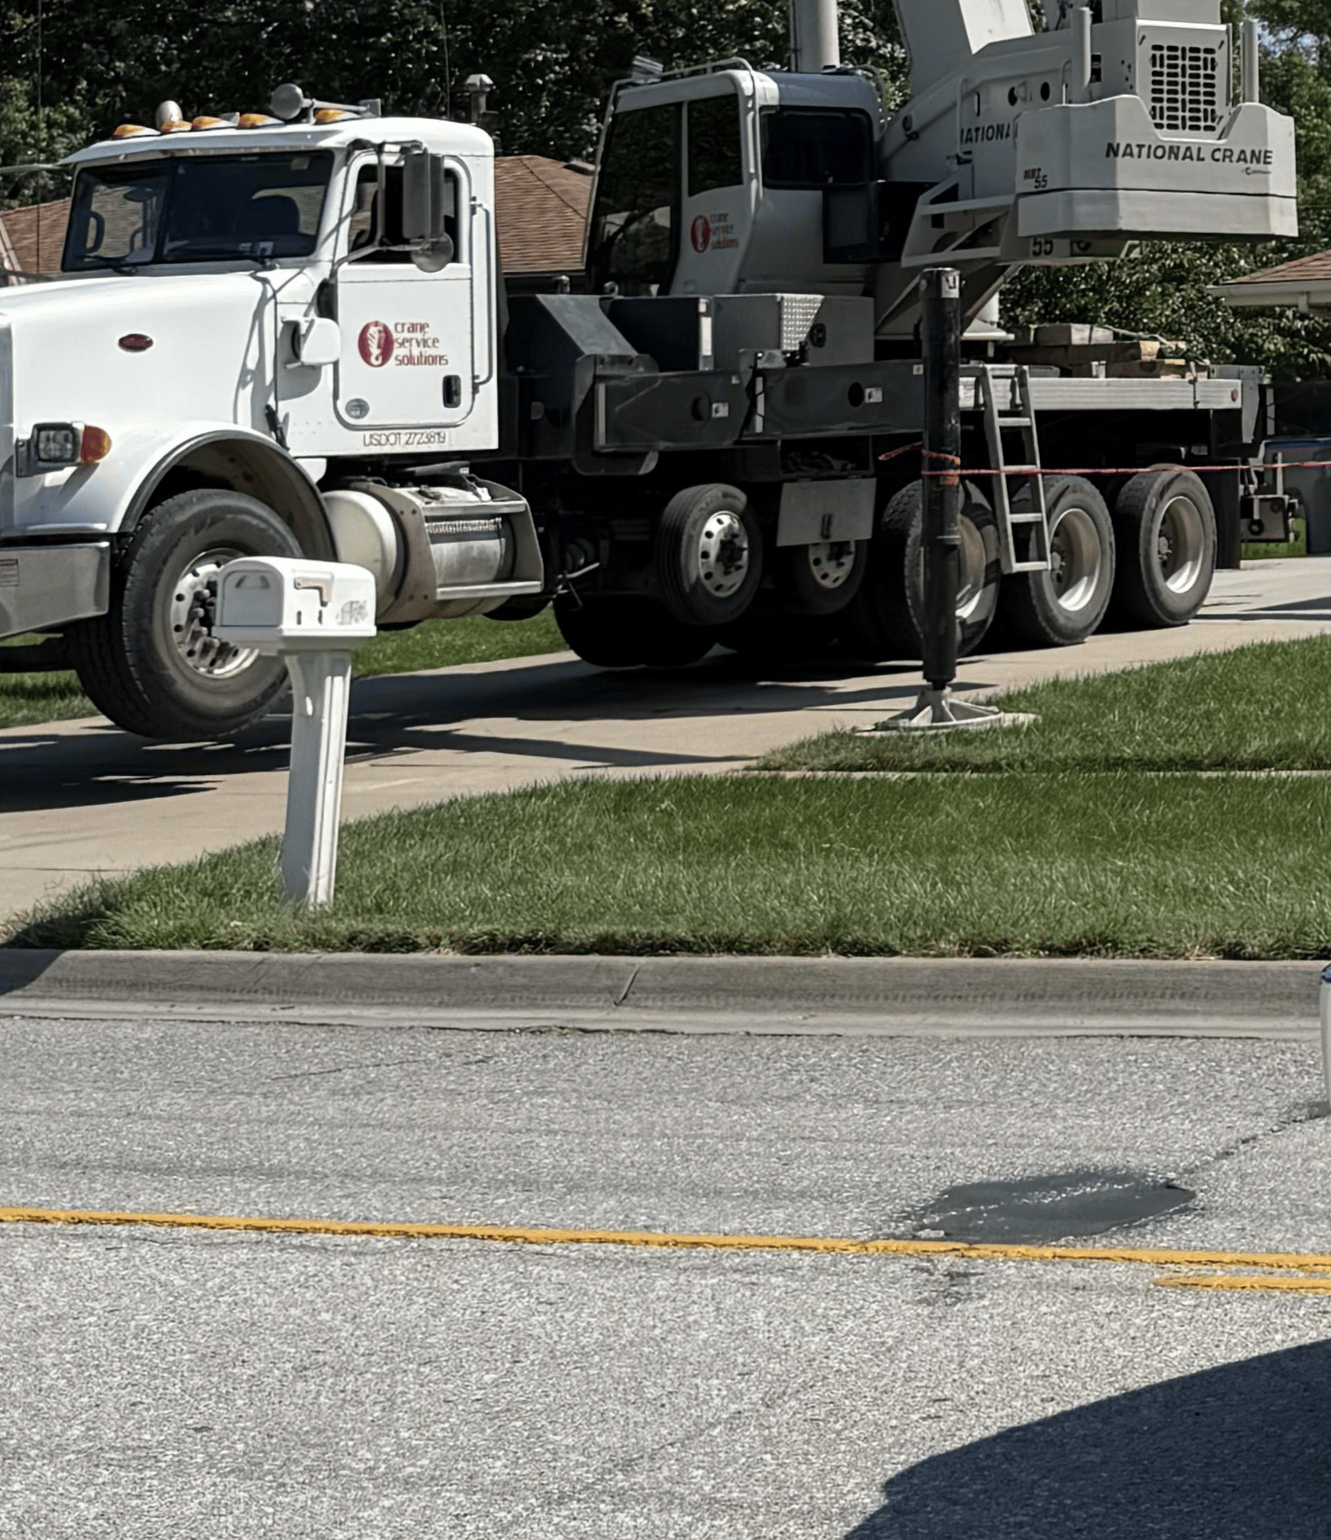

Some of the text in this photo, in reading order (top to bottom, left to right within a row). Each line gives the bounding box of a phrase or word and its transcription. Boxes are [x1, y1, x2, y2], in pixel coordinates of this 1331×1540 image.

[1105, 142, 1274, 165] NATIONAL CRANE
[394, 321, 430, 334] crane
[394, 336, 440, 349] service
[394, 350, 449, 366] solutions
[363, 433, 400, 447] USDOT
